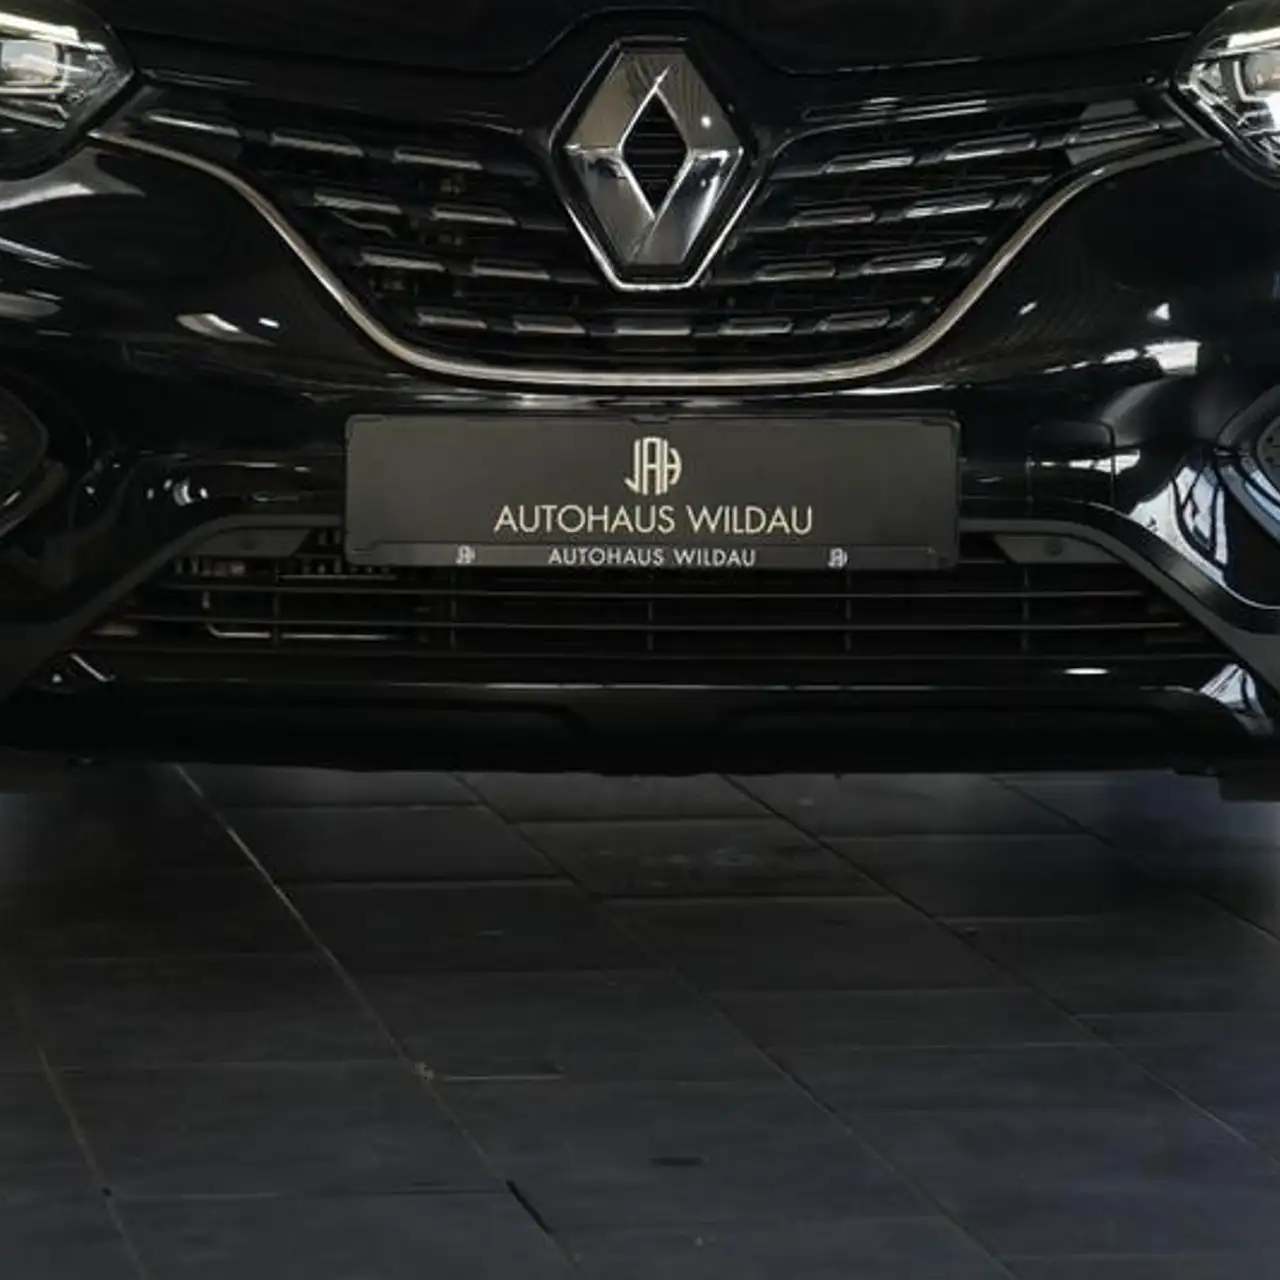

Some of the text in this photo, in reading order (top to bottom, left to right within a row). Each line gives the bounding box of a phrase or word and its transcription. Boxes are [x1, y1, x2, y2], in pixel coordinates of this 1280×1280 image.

[493, 504, 813, 535] AUTOHAUS WILDAU
[547, 547, 756, 567] AUTOHAUS WILDAU
